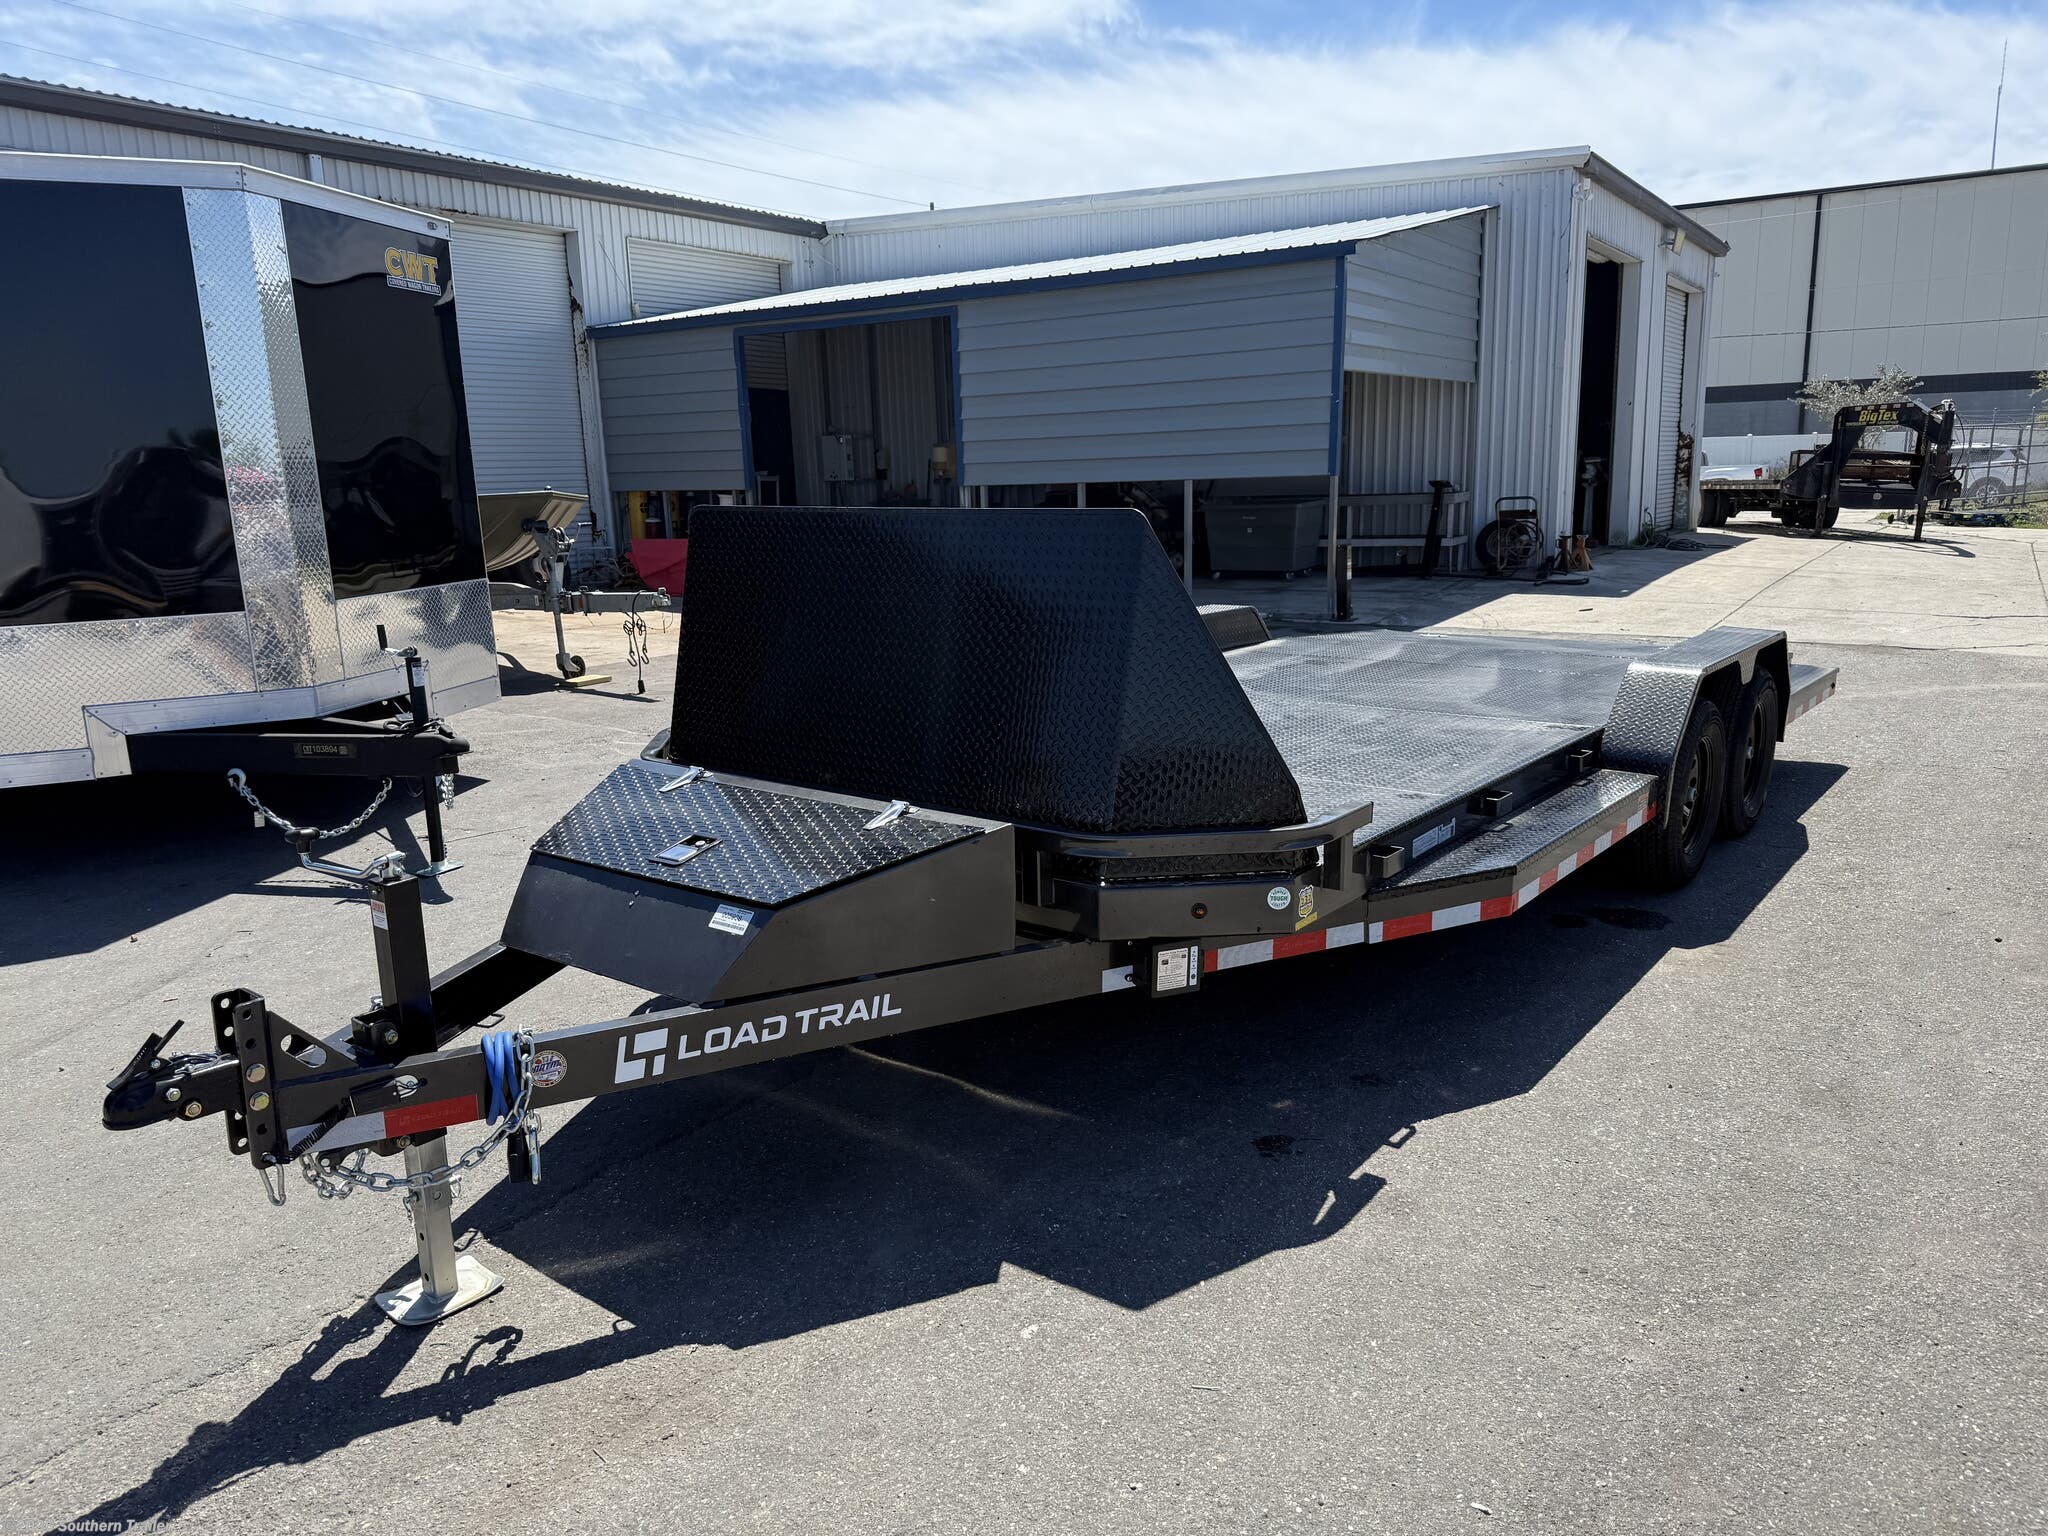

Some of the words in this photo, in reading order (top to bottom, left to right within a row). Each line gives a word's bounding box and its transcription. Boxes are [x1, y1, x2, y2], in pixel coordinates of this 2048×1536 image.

[385, 247, 438, 284] CWT
[677, 1014, 788, 1060] LOAD
[794, 993, 902, 1034] TRAIL
